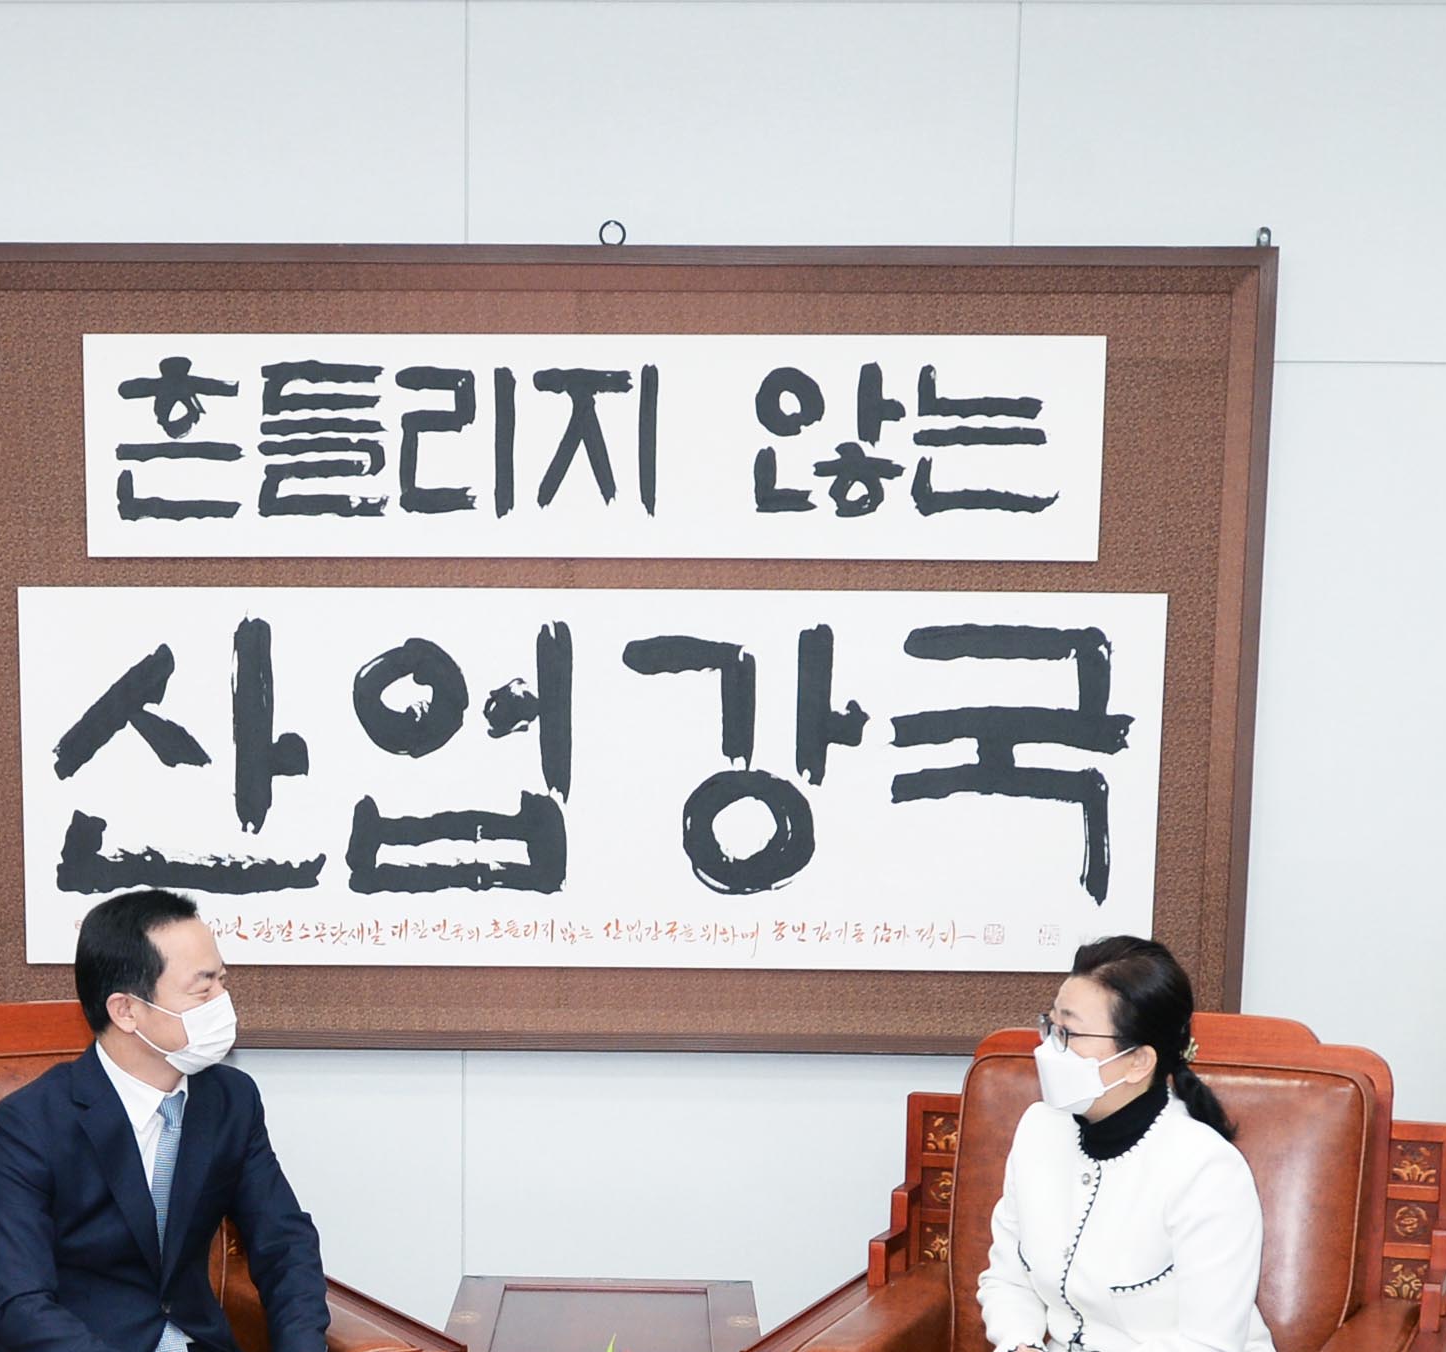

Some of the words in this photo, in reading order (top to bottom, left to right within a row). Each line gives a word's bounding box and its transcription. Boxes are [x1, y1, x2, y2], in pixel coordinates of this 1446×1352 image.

[115, 355, 660, 522] 흔들리지
[753, 361, 1061, 518] 않는
[53, 612, 1135, 906] 산업강국
